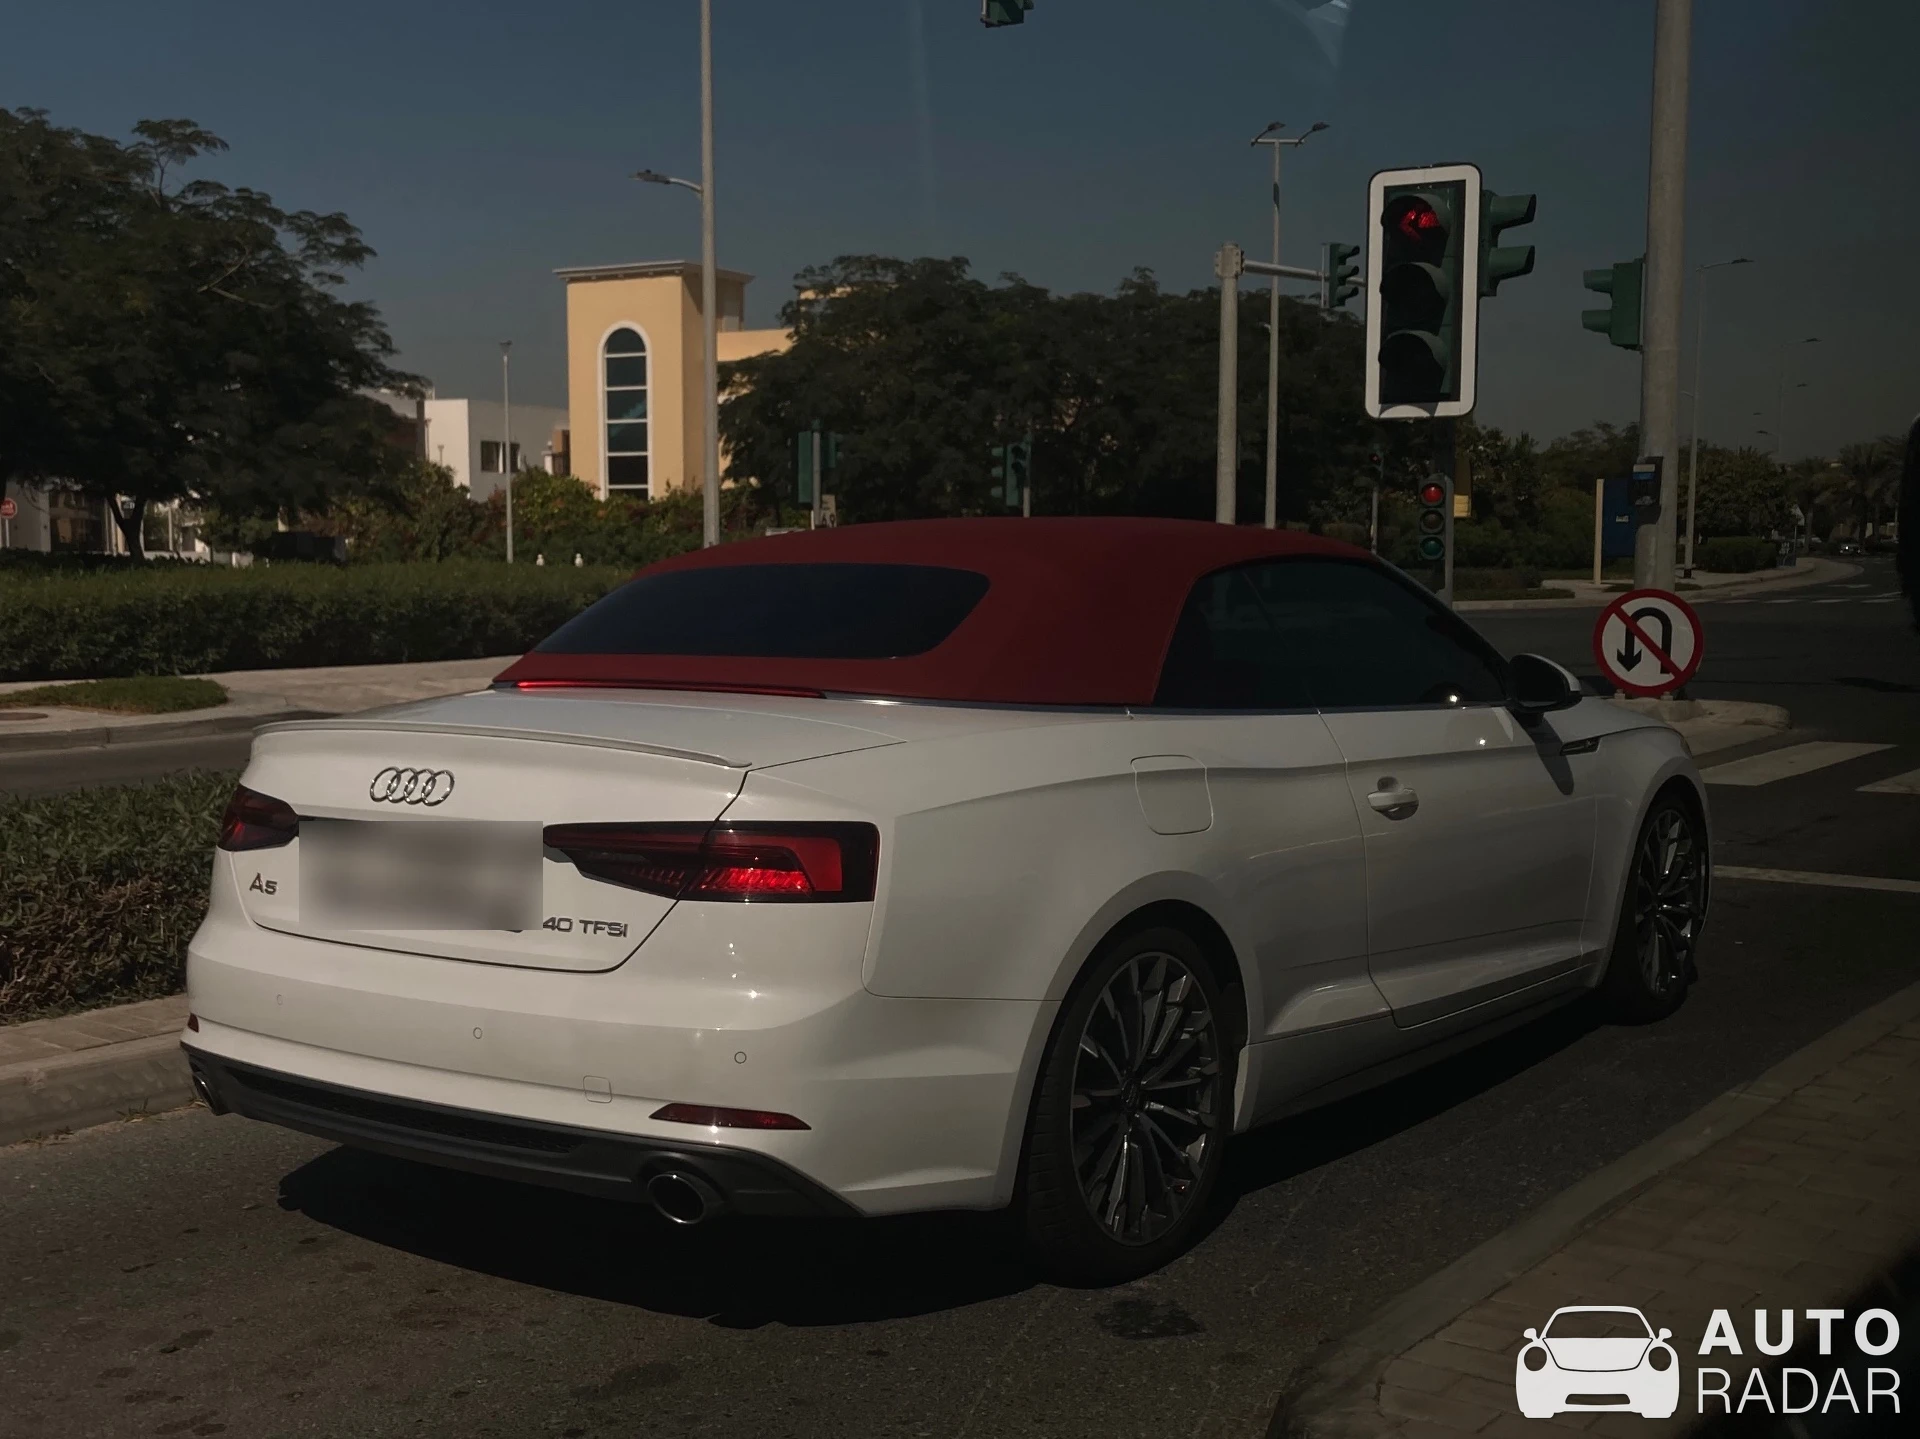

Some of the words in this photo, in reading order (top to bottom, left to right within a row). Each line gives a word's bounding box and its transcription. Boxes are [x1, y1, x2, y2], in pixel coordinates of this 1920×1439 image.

[249, 872, 277, 895] A5
[543, 917, 573, 932] 40
[579, 920, 628, 938] TFSI
